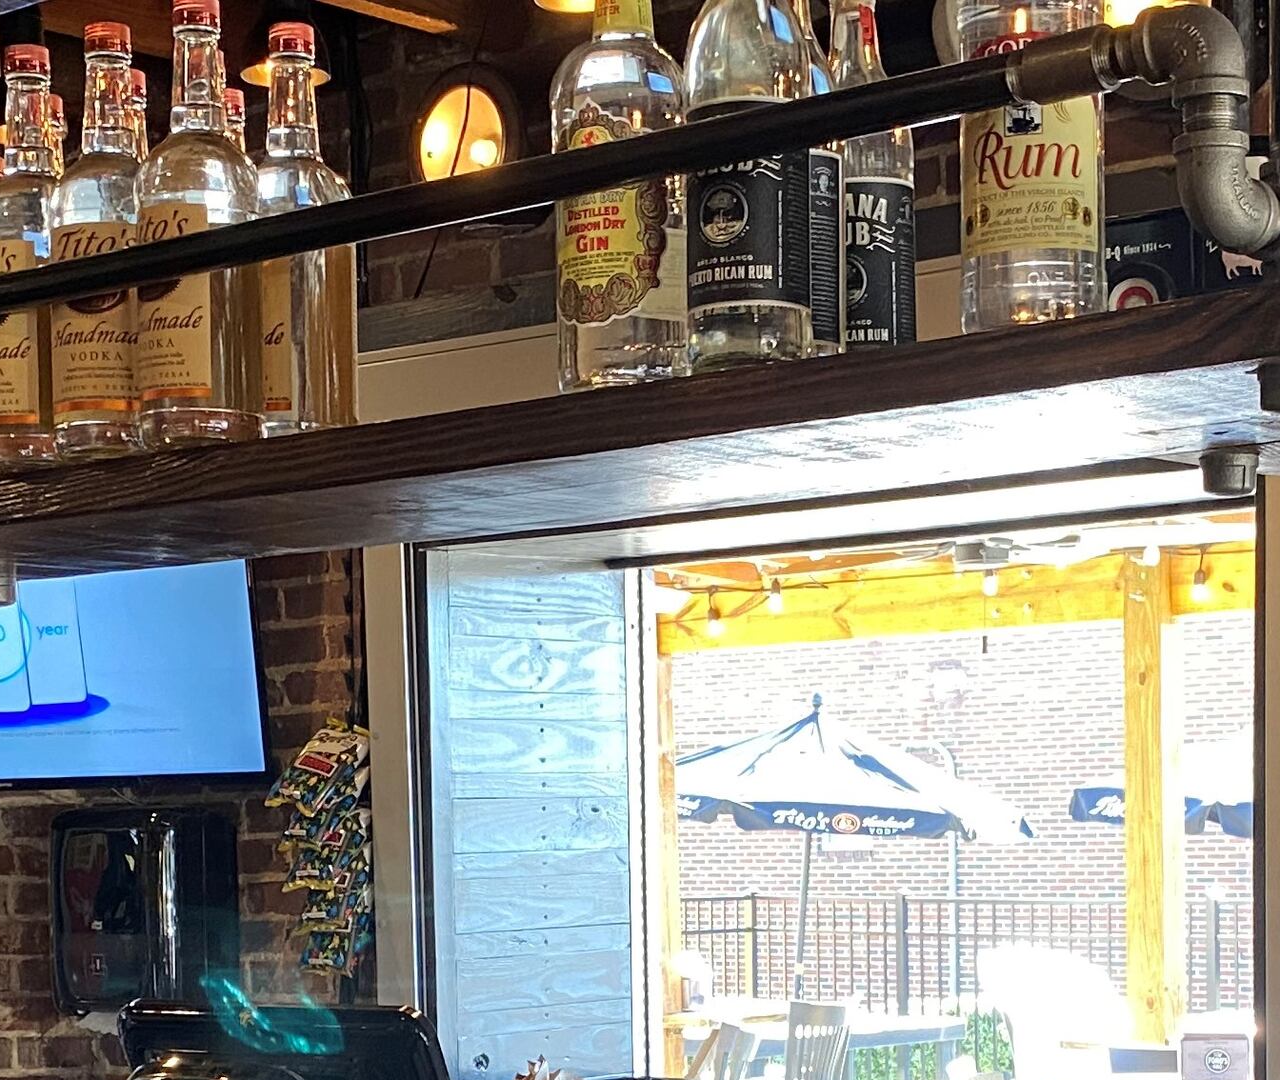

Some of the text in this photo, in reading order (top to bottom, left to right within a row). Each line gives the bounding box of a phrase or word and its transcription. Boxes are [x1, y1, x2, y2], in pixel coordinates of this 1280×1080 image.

[973, 122, 1081, 190] Rum
[567, 205, 619, 222] DISTILLED
[564, 217, 626, 237] LONDON DRY
[576, 235, 609, 254] GIN
[714, 265, 746, 281] RICAN
[747, 264, 773, 280] RUM
[866, 327, 889, 341] RUM
[69, 350, 124, 362] VODKA
[35, 623, 70, 641] year
